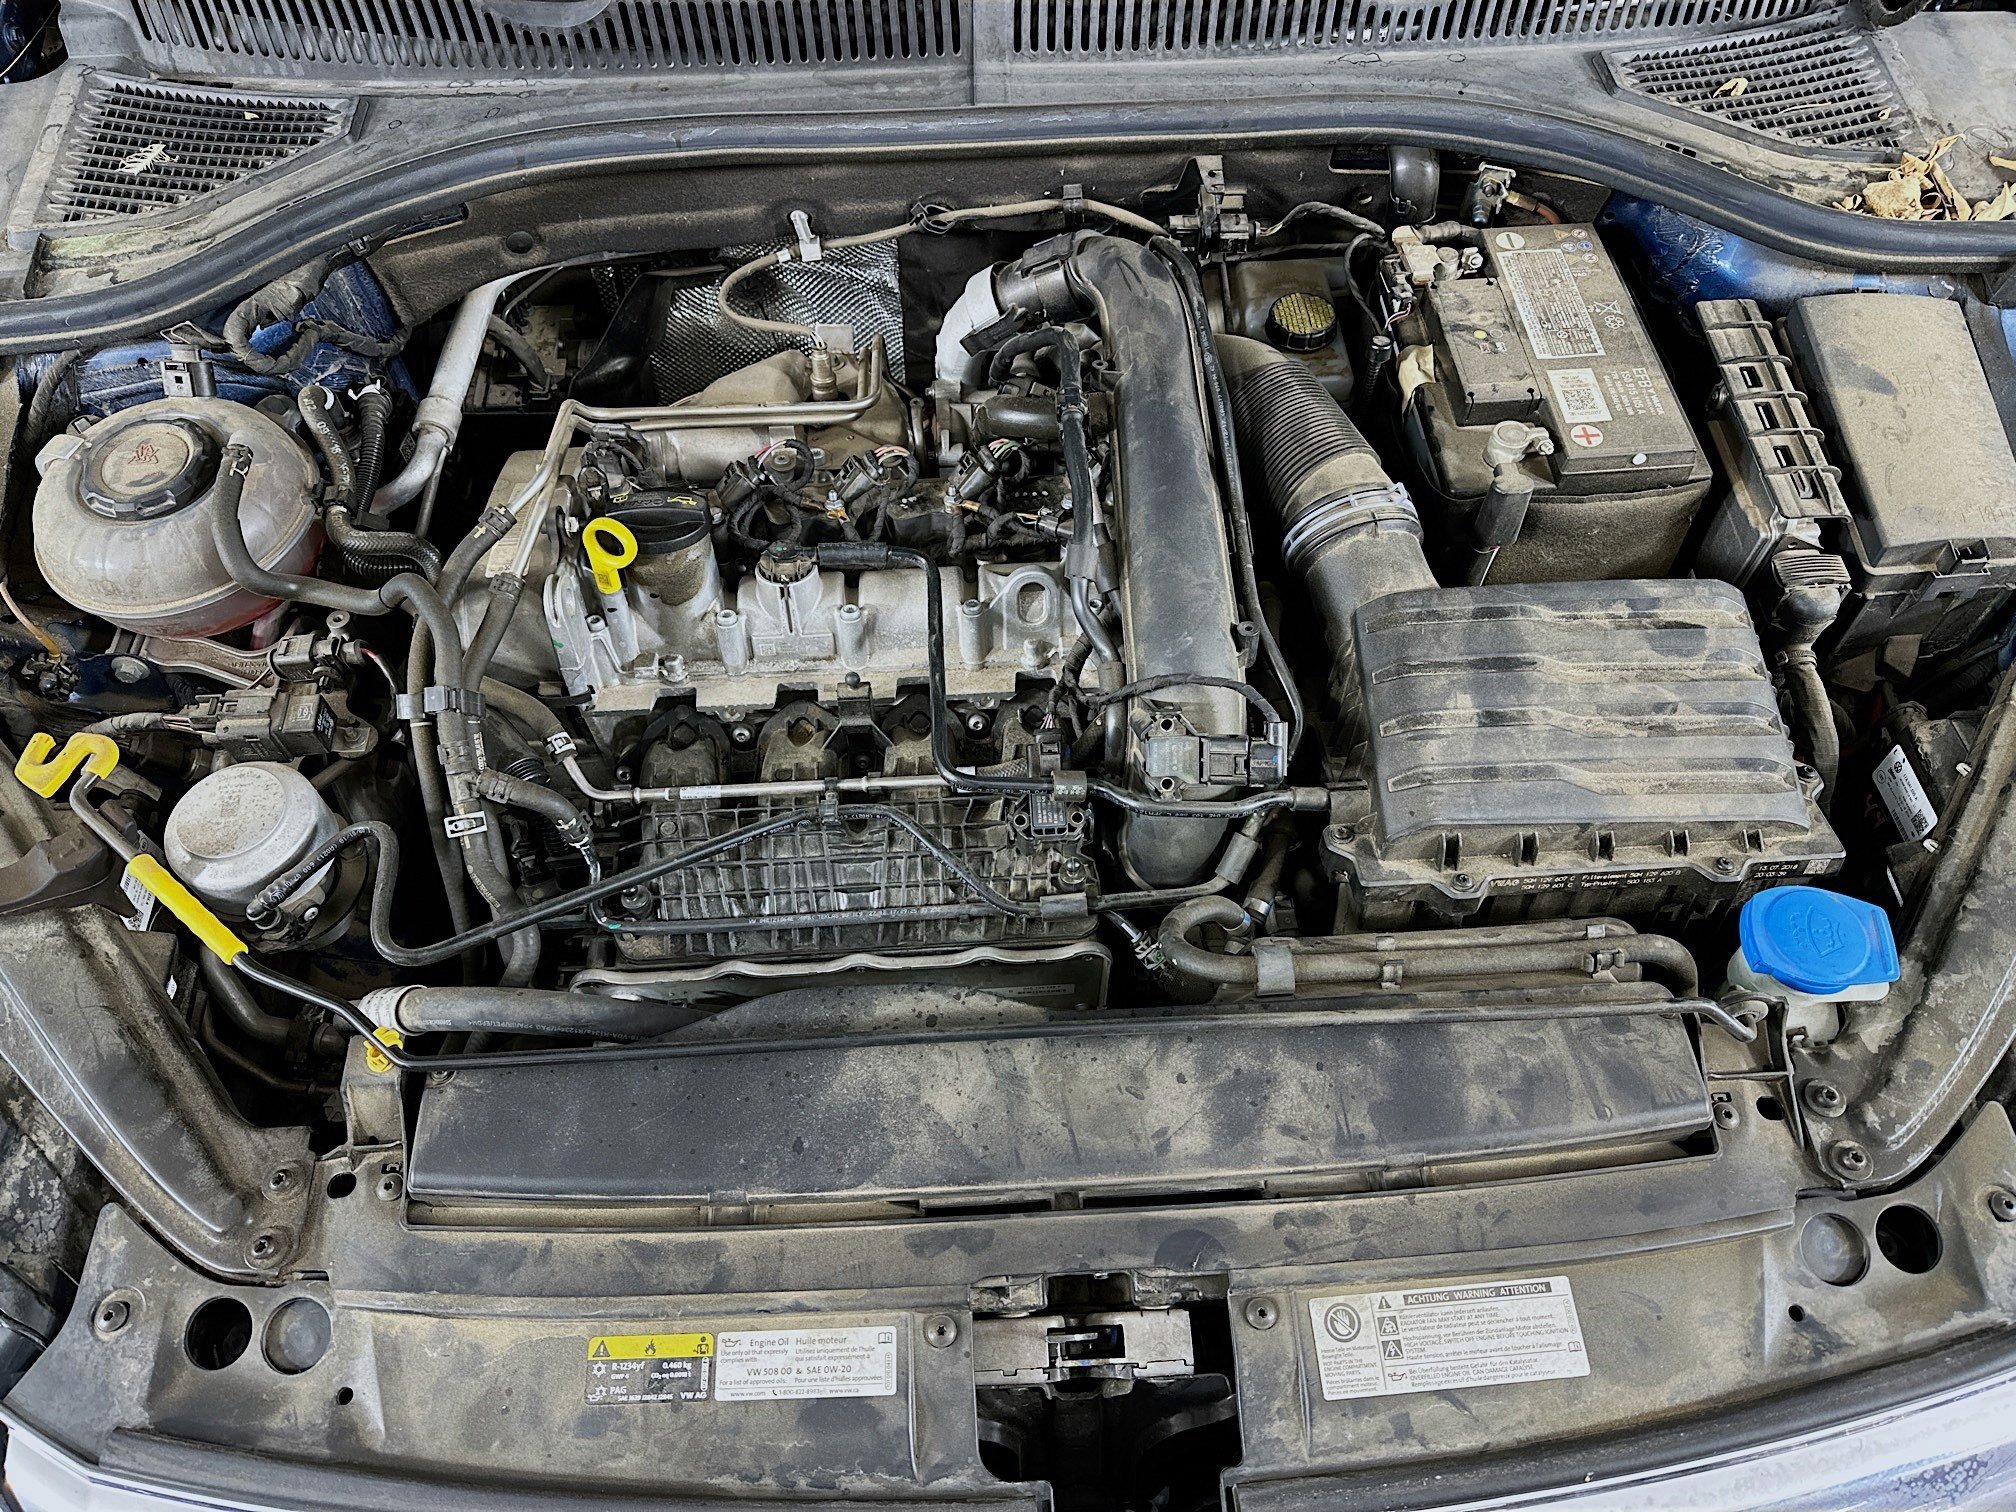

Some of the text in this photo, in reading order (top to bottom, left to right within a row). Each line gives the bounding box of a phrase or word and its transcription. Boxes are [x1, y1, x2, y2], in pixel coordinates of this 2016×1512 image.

[1632, 368, 1652, 387] EFB
[1408, 1284, 1546, 1304] ACHTUNG WARNING ATTENTION
[1408, 1324, 1435, 1332] ventilateur
[750, 1339, 776, 1348] Engine
[778, 1338, 789, 1346] Oil
[796, 1337, 816, 1345] Huile
[611, 1361, 645, 1372] R-1234yf
[683, 1361, 692, 1370] kg
[781, 1367, 792, 1375] 00
[807, 1366, 822, 1374] SAE
[824, 1365, 852, 1374] 0W-20
[1410, 1373, 1440, 1381] OVERFILLED
[750, 1379, 775, 1387] approved
[610, 1386, 626, 1394] PAG
